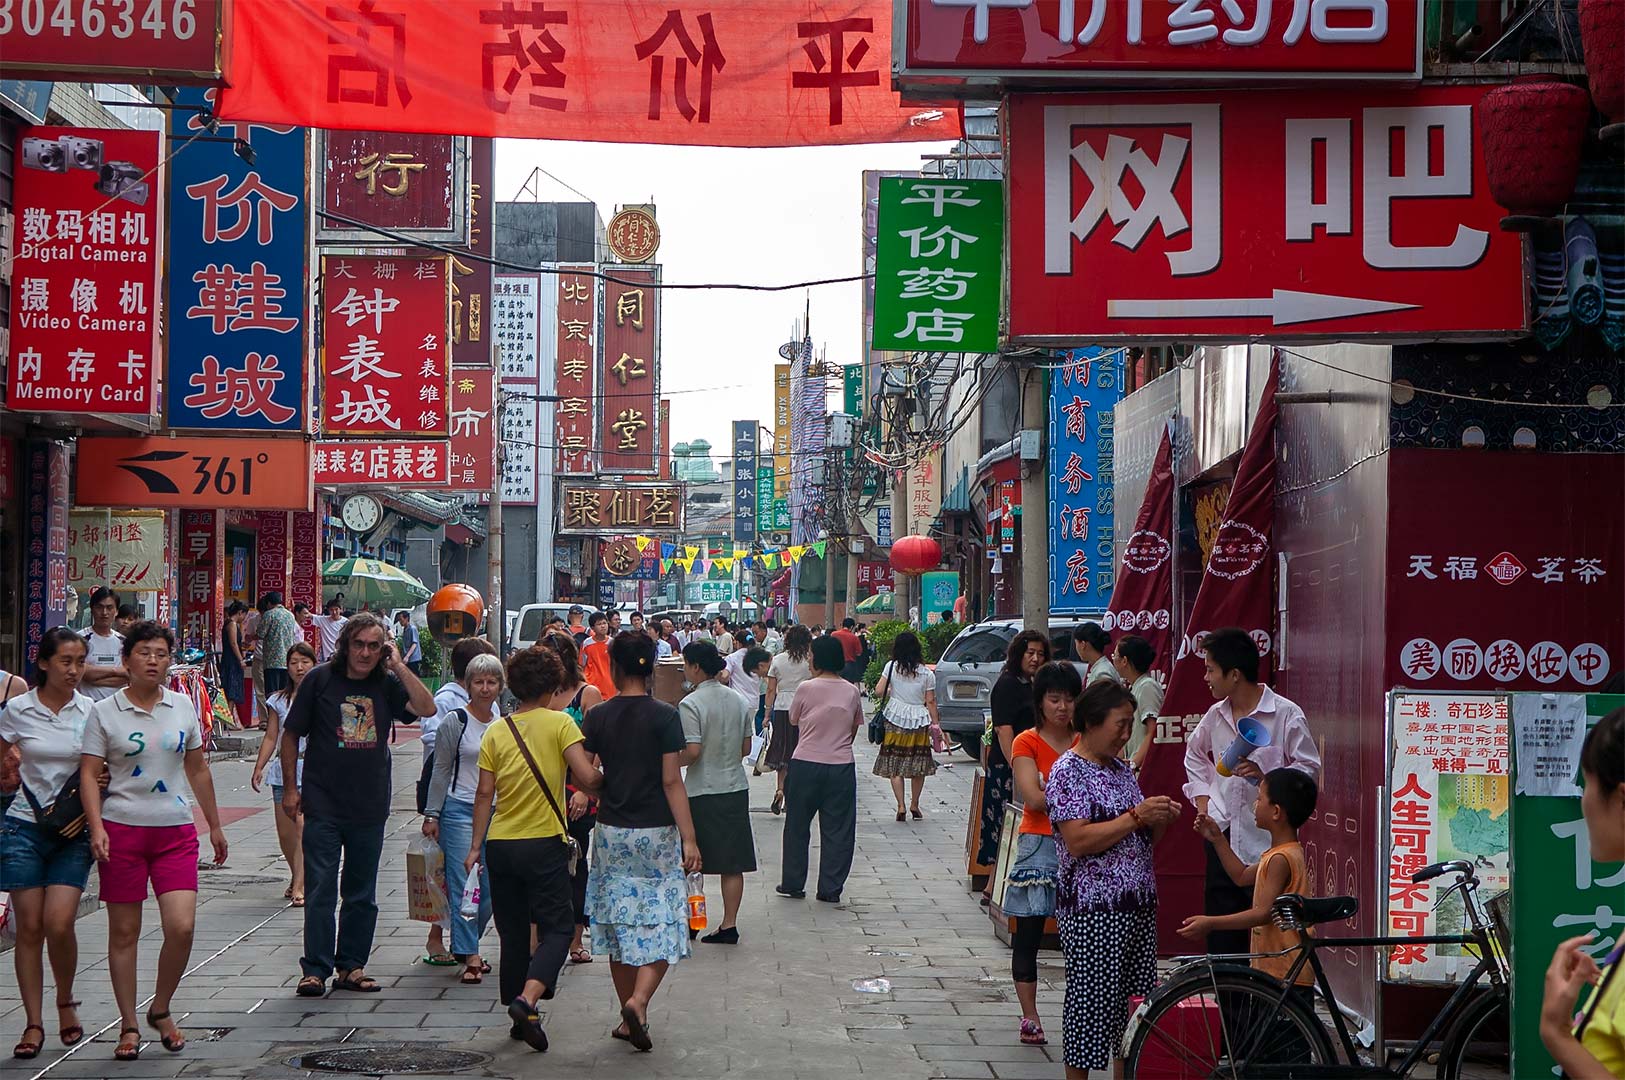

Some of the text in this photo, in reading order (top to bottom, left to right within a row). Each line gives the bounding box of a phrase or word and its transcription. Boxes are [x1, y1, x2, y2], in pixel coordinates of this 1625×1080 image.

[354, 152, 426, 196] 行
[1044, 103, 1489, 278] 网吧
[22, 208, 150, 246] 数码相机
[21, 243, 147, 263] Digtal Camera
[333, 259, 439, 280] 大栅栏
[894, 184, 980, 343] 平价药店
[20, 278, 148, 315] 摄像机
[19, 312, 146, 333] Video Camera
[17, 347, 147, 384] 内存卡
[330, 287, 402, 430] 钟表城
[611, 289, 648, 450] 同仁堂
[16, 384, 145, 403] Memory Card
[417, 333, 441, 430] 名表维修
[736, 430, 754, 518] 上海张小泉
[1097, 411, 1115, 516] BUSINESS
[567, 488, 678, 527] 聚仙茗
[611, 544, 634, 570] 茶
[1097, 526, 1115, 597] HOTEL
[187, 530, 212, 640] 亨得利
[1404, 640, 1606, 683] 美丽换妆中
